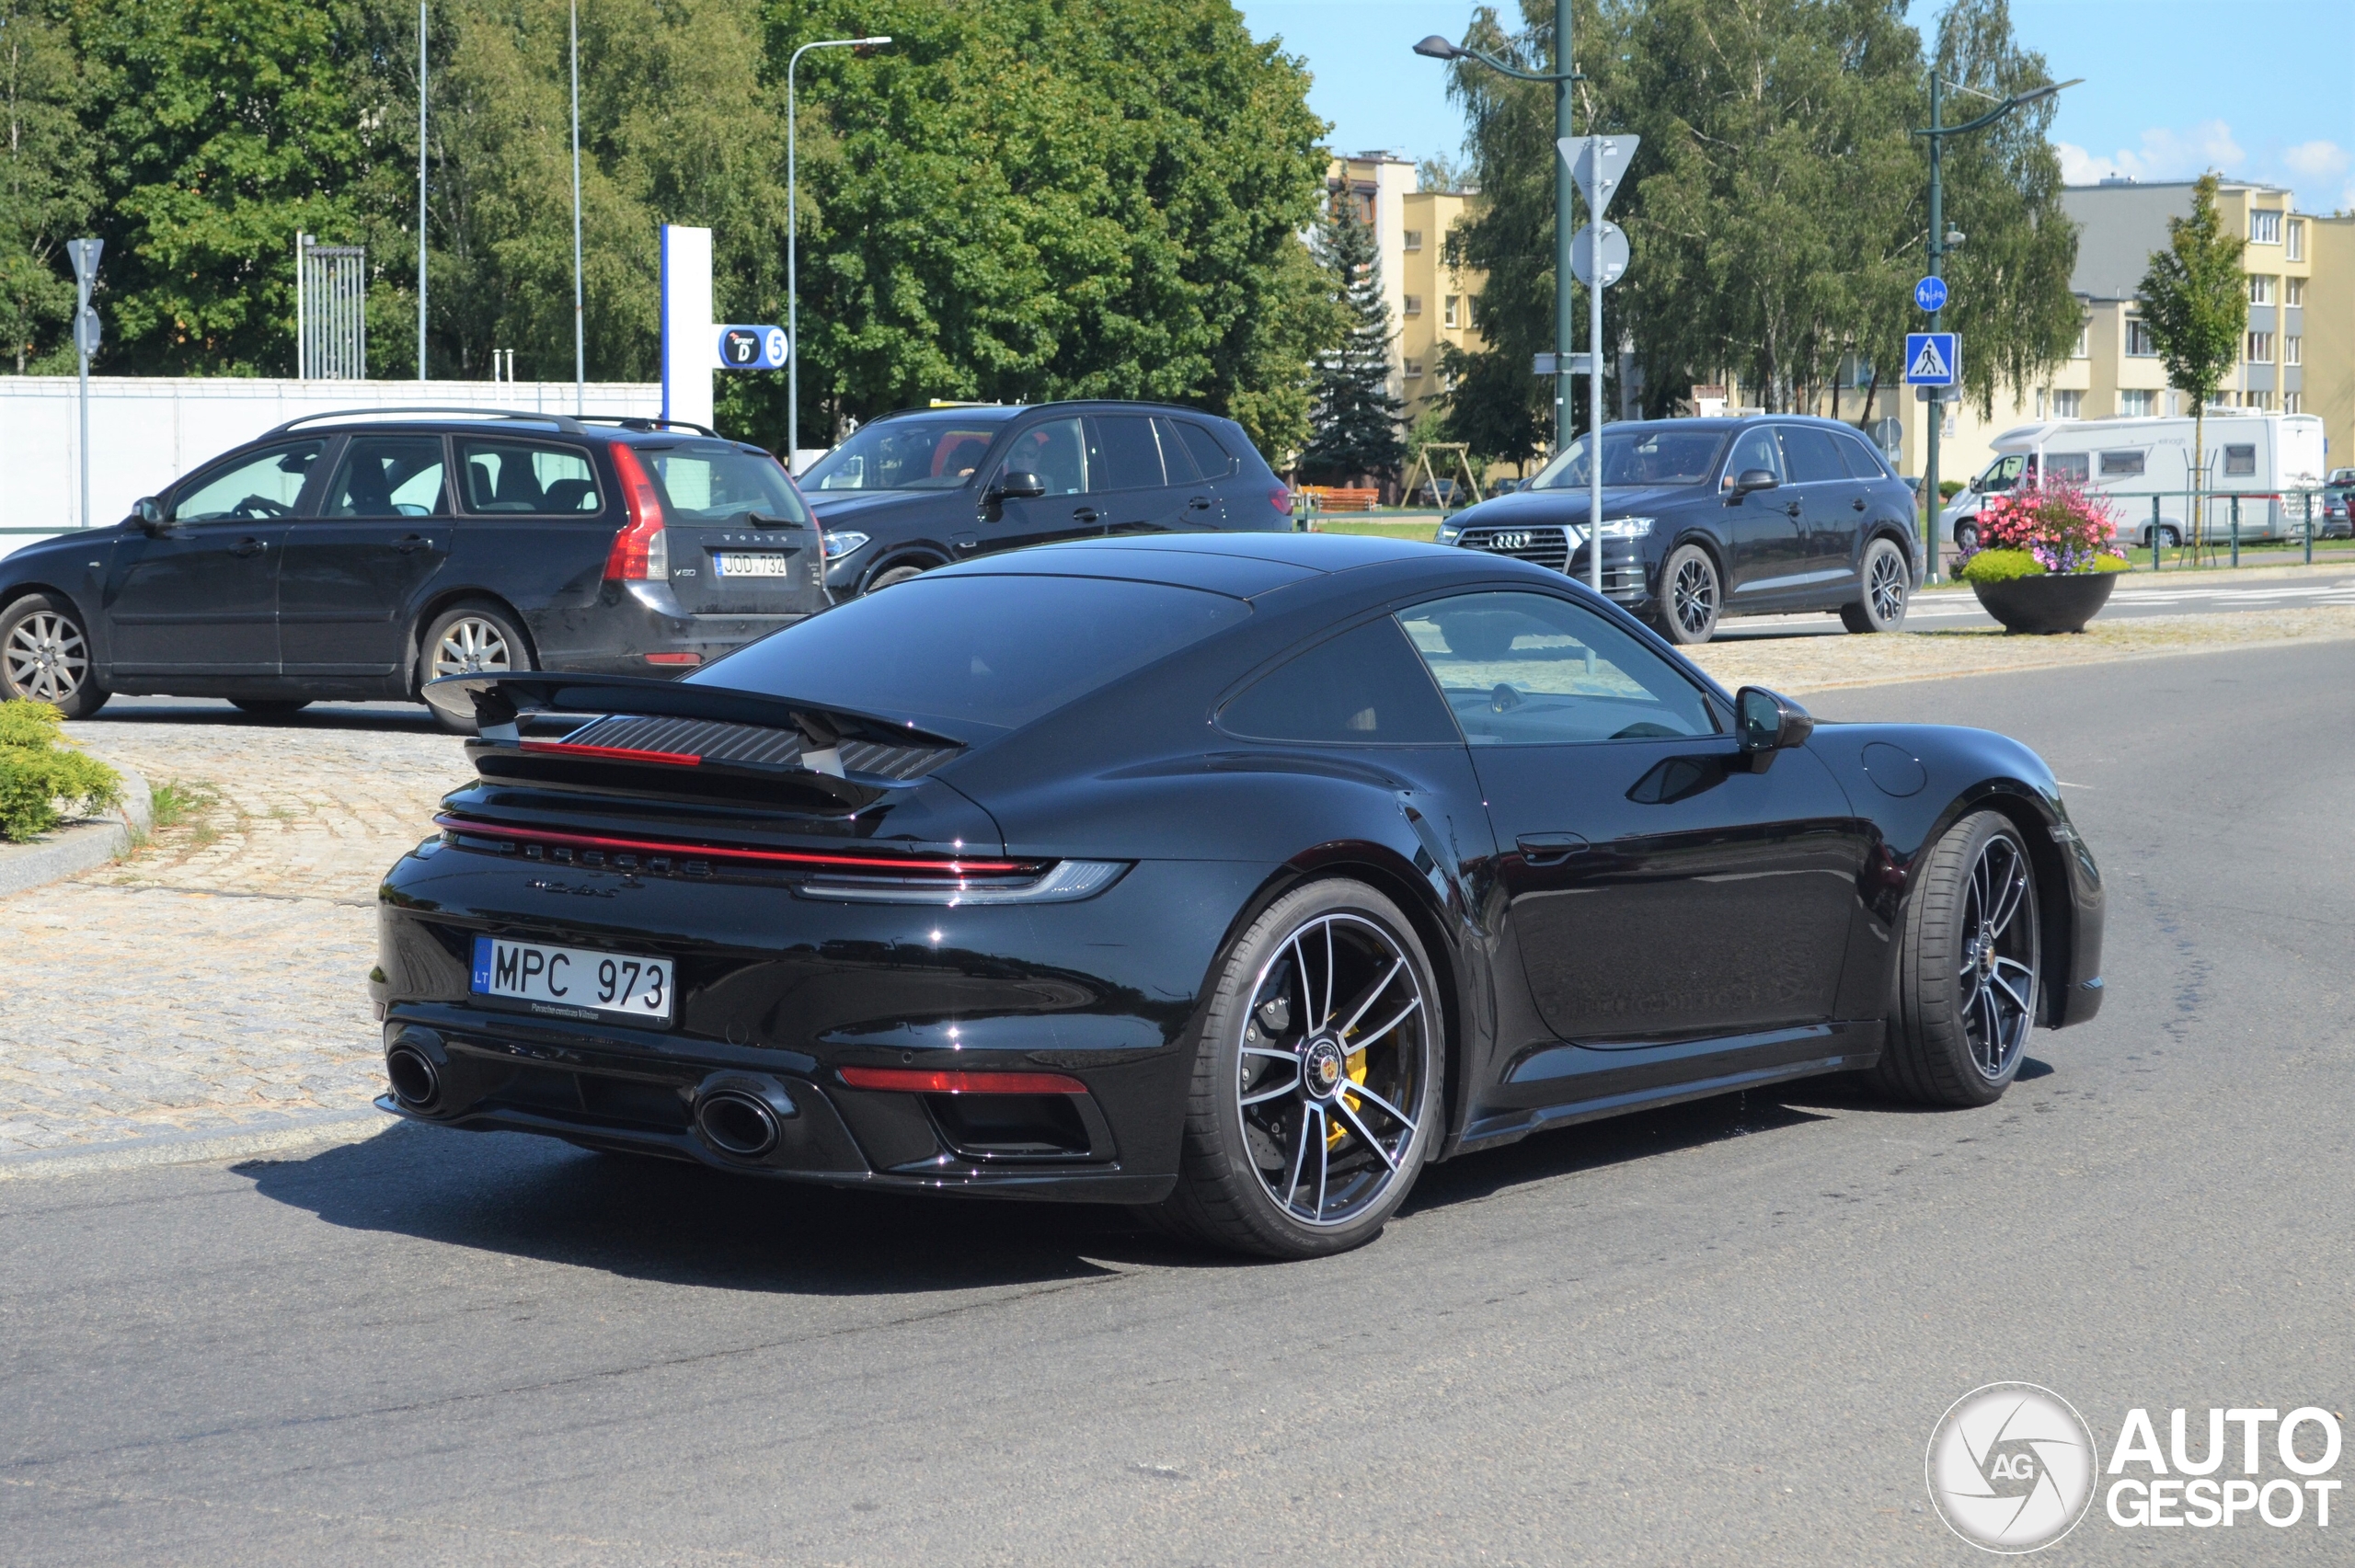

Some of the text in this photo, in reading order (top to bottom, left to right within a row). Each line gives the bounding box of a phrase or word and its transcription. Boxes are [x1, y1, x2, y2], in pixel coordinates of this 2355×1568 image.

[738, 344, 751, 361] D
[772, 336, 782, 360] 5
[673, 568, 696, 577] V50
[724, 555, 784, 573] JOD 732
[499, 840, 714, 876] PORSCHE
[474, 970, 488, 985] LT
[495, 945, 664, 1010] MPC 973
[531, 1002, 556, 1014] Porsche
[578, 1009, 599, 1021] Vilnius
